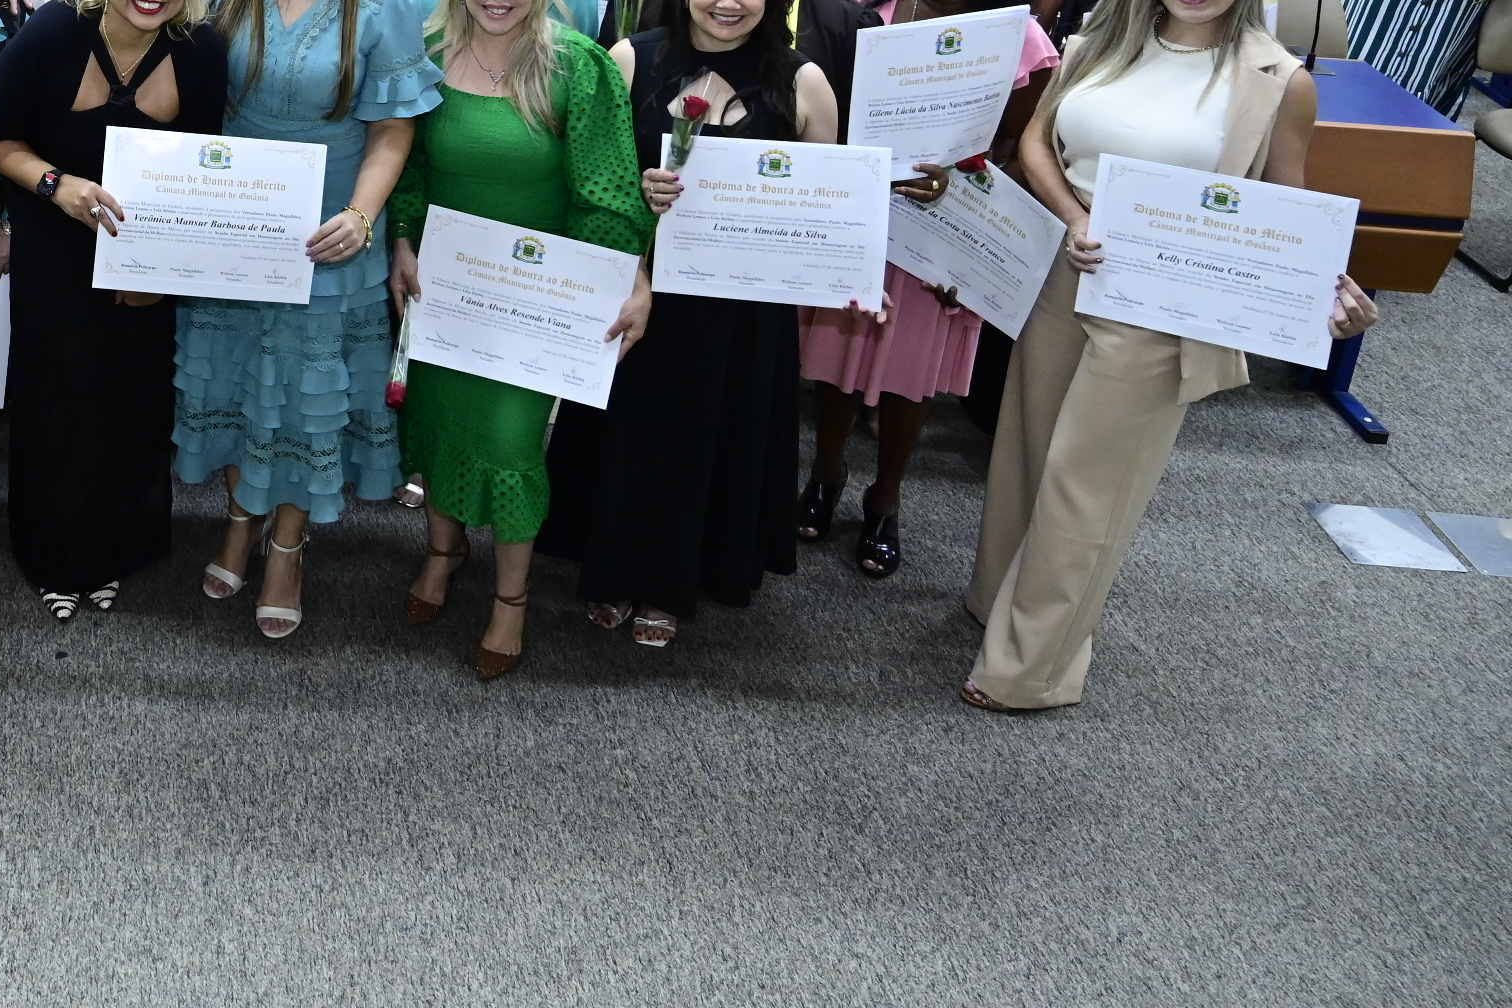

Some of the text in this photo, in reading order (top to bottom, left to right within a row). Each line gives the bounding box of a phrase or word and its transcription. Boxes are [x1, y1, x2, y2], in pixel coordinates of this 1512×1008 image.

[134, 213, 172, 224] Verônica
[173, 216, 208, 228] Mansur
[210, 219, 246, 230] Barbosa
[260, 223, 286, 234] Paula
[713, 223, 828, 240] Luciene Almeida da Silva
[1156, 250, 1262, 281] Kelly Cristina Castro
[459, 294, 572, 330] Vânia Alves Resende Viana
